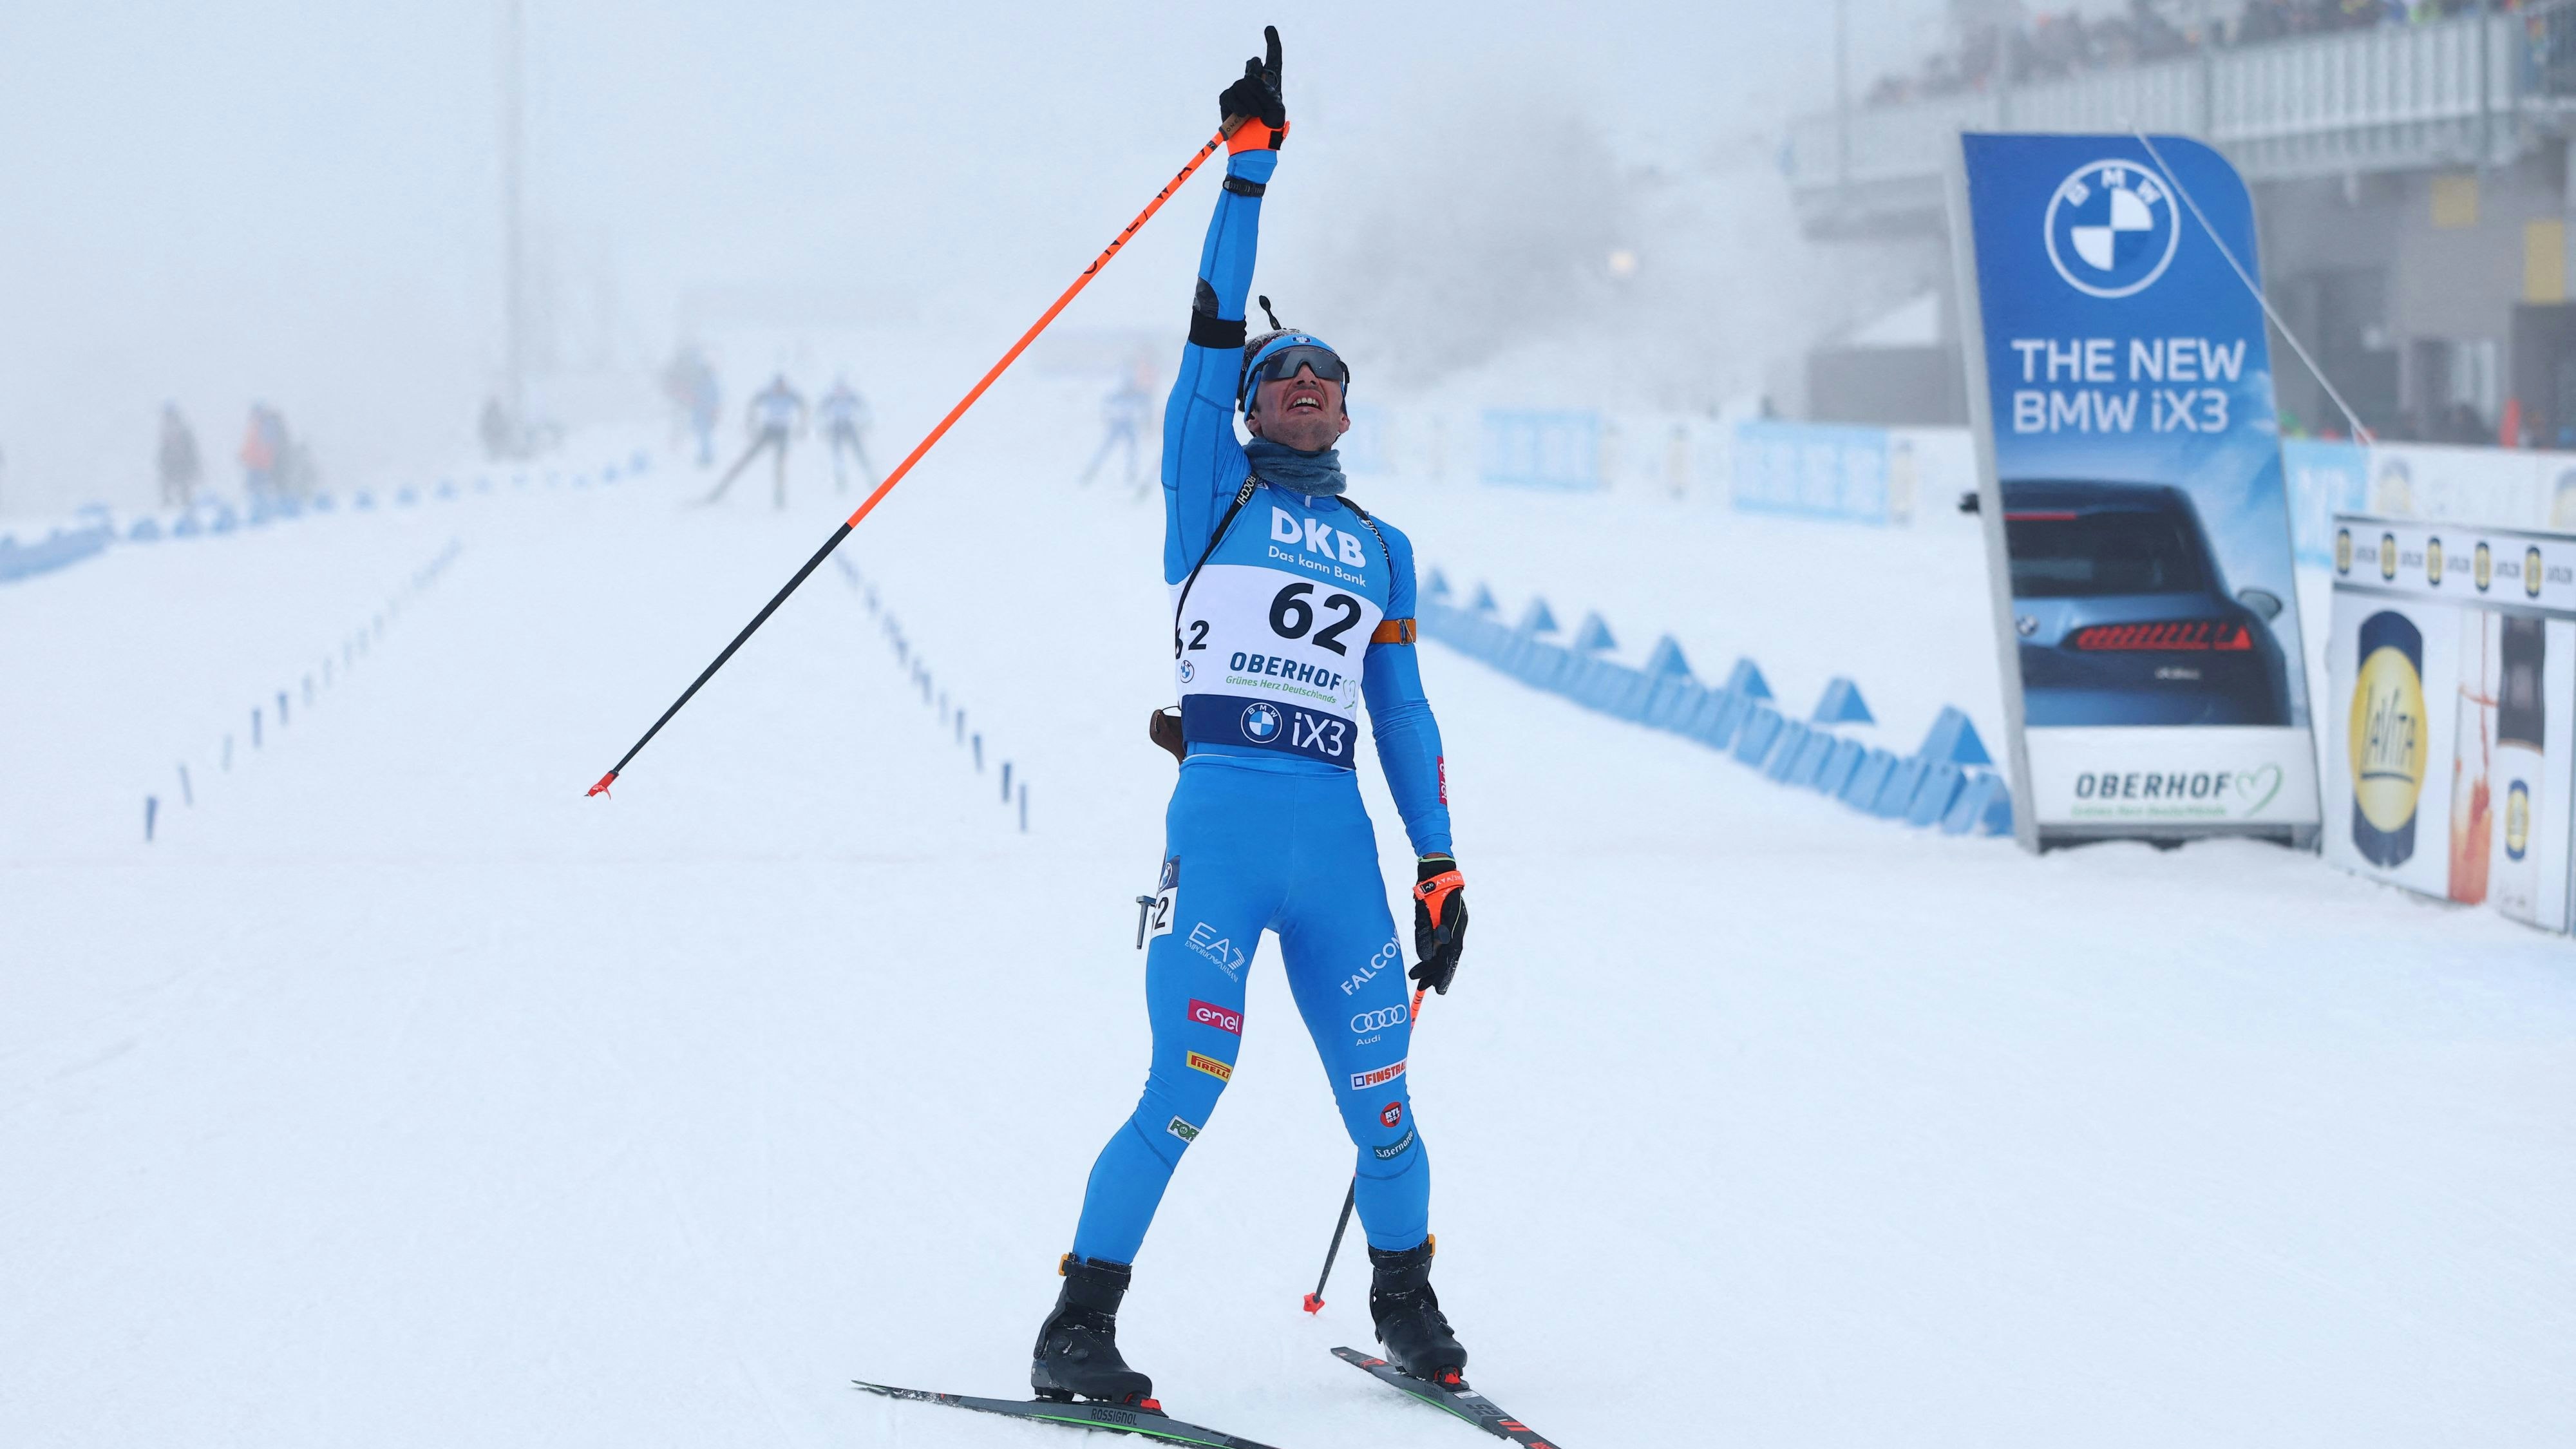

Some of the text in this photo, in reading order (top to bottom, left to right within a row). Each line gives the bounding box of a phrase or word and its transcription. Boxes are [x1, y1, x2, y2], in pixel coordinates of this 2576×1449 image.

[2063, 168, 2163, 207] BMW
[2011, 338, 2246, 383] THE NEW
[2012, 389, 2230, 433] BMW iX3
[1270, 506, 1367, 568] DKB
[1268, 545, 1367, 587] Das kann Bank
[1269, 582, 1361, 657] 62
[1226, 675, 1338, 704] Grünes Herz Deutschlands
[1230, 652, 1342, 691] OBERHOF
[1247, 705, 1278, 718] BMW
[1292, 712, 1347, 757] iX3
[2075, 772, 2231, 800] OBERHOF
[1184, 940, 1239, 983] EMPORIO ARMANI
[1340, 928, 1400, 996] FALCON
[1196, 1007, 1240, 1032] enel
[1356, 1034, 1381, 1046] Audi
[1191, 1054, 1231, 1079] PIRELLI
[1385, 1107, 1400, 1119] RTL
[1091, 1407, 1137, 1426] ROSSIGNOL
